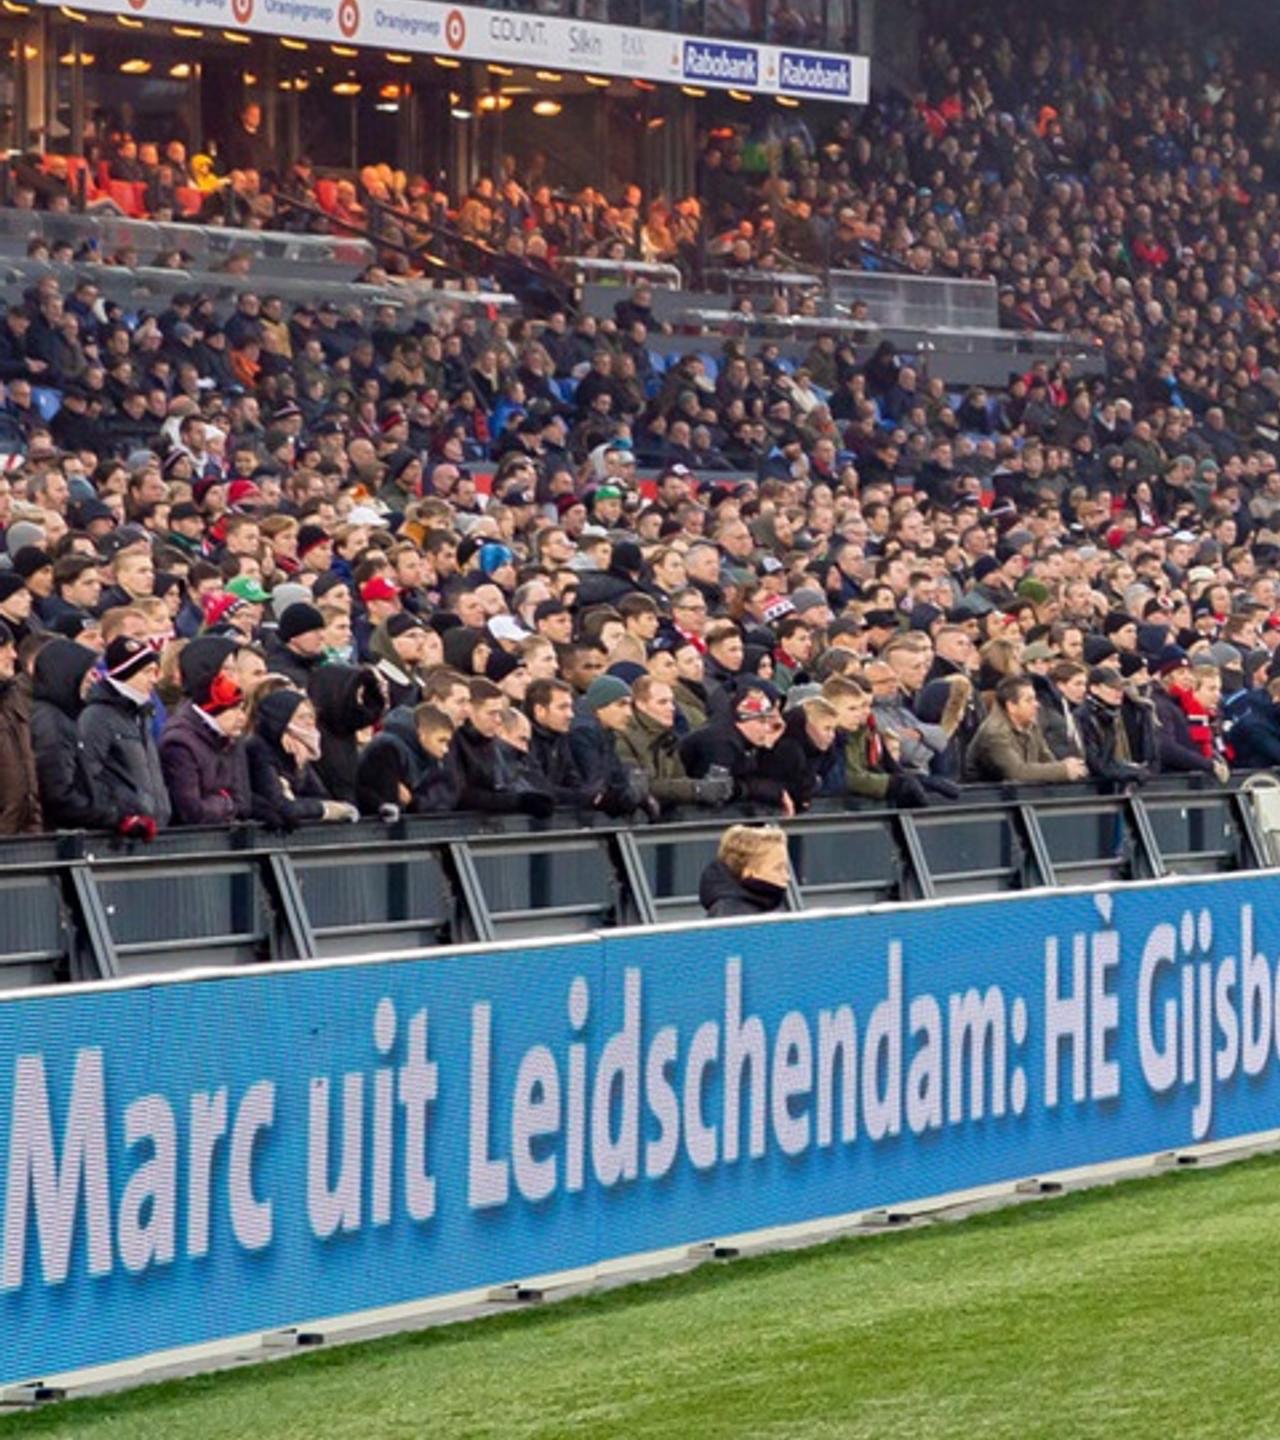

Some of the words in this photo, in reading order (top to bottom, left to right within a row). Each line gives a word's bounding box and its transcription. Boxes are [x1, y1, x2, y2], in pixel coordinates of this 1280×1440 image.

[373, 8, 440, 37] Oranjegroep
[687, 45, 757, 81] Rabobank
[783, 56, 849, 92] Rabobank
[2, 1047, 276, 1292] Marc
[307, 996, 438, 1237] uit
[466, 939, 1027, 1211] Leidschendam:
